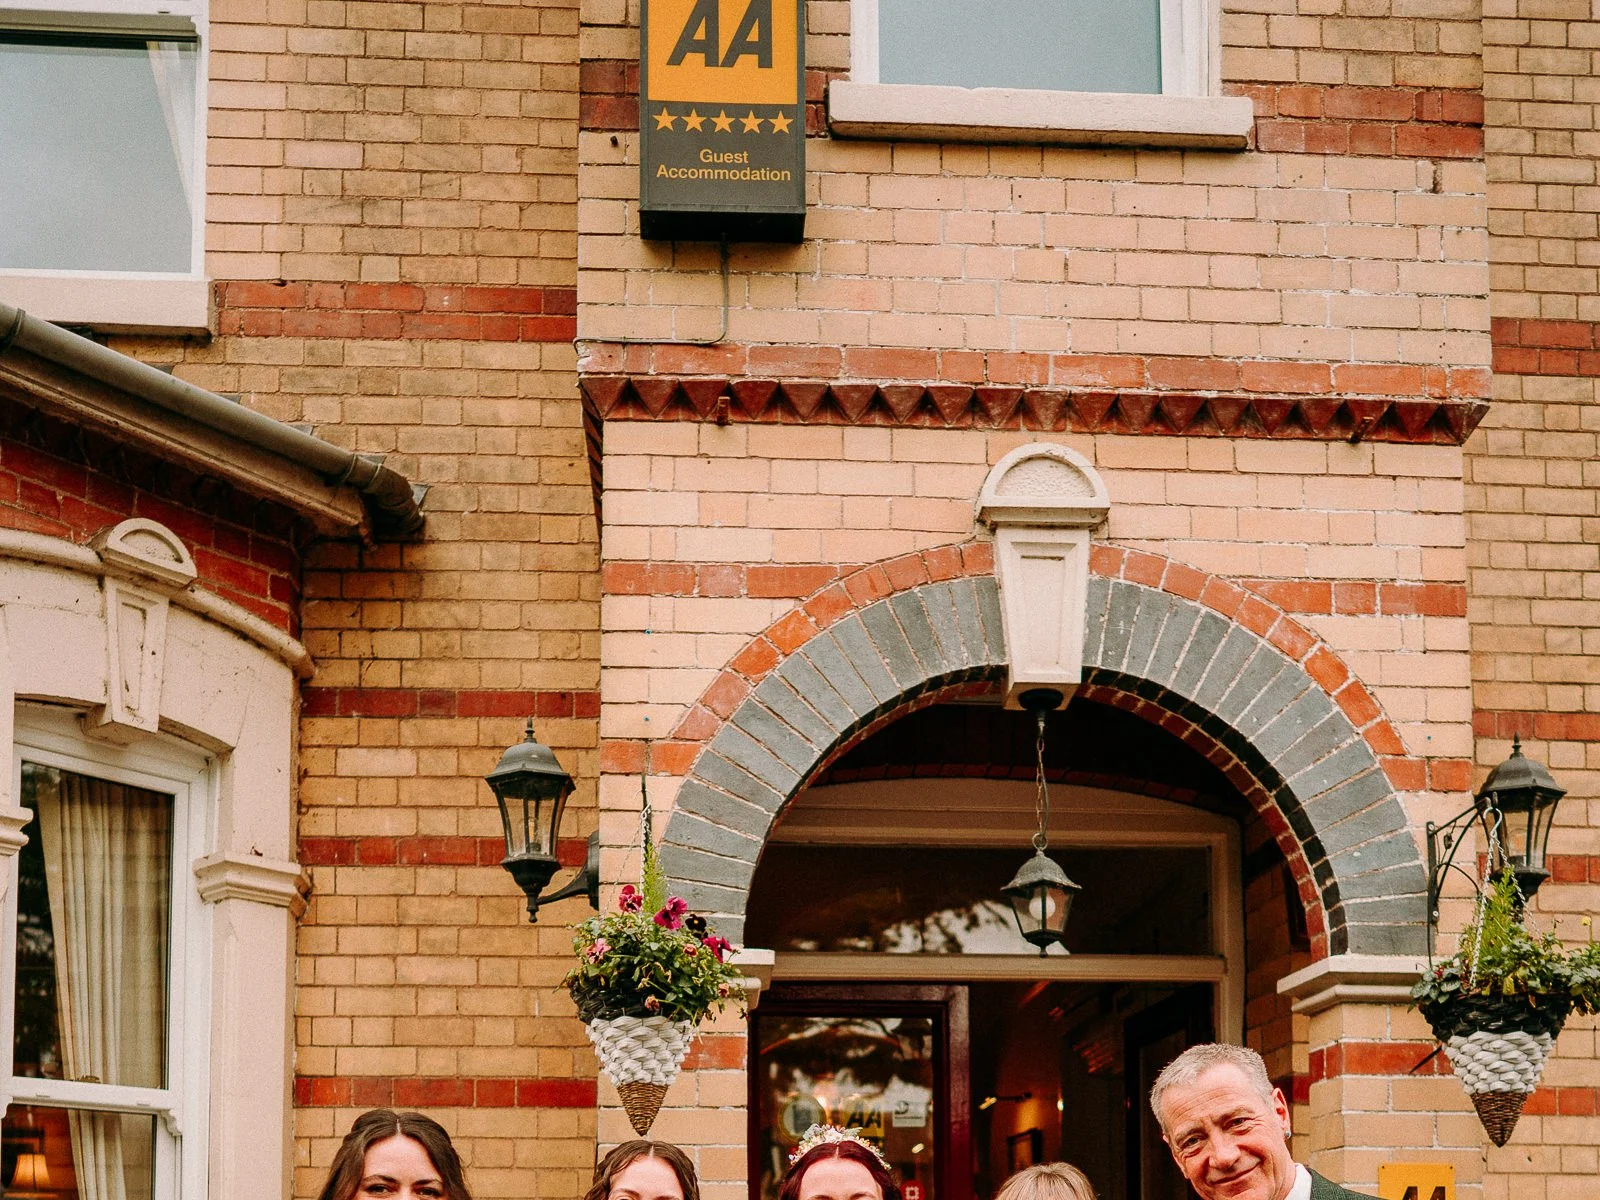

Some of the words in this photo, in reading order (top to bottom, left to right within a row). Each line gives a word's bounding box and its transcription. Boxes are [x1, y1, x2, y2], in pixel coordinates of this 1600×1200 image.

[666, 0, 773, 69] AA
[699, 148, 749, 164] Guest
[656, 164, 791, 181] Accommodation
[846, 1102, 882, 1128] AA
